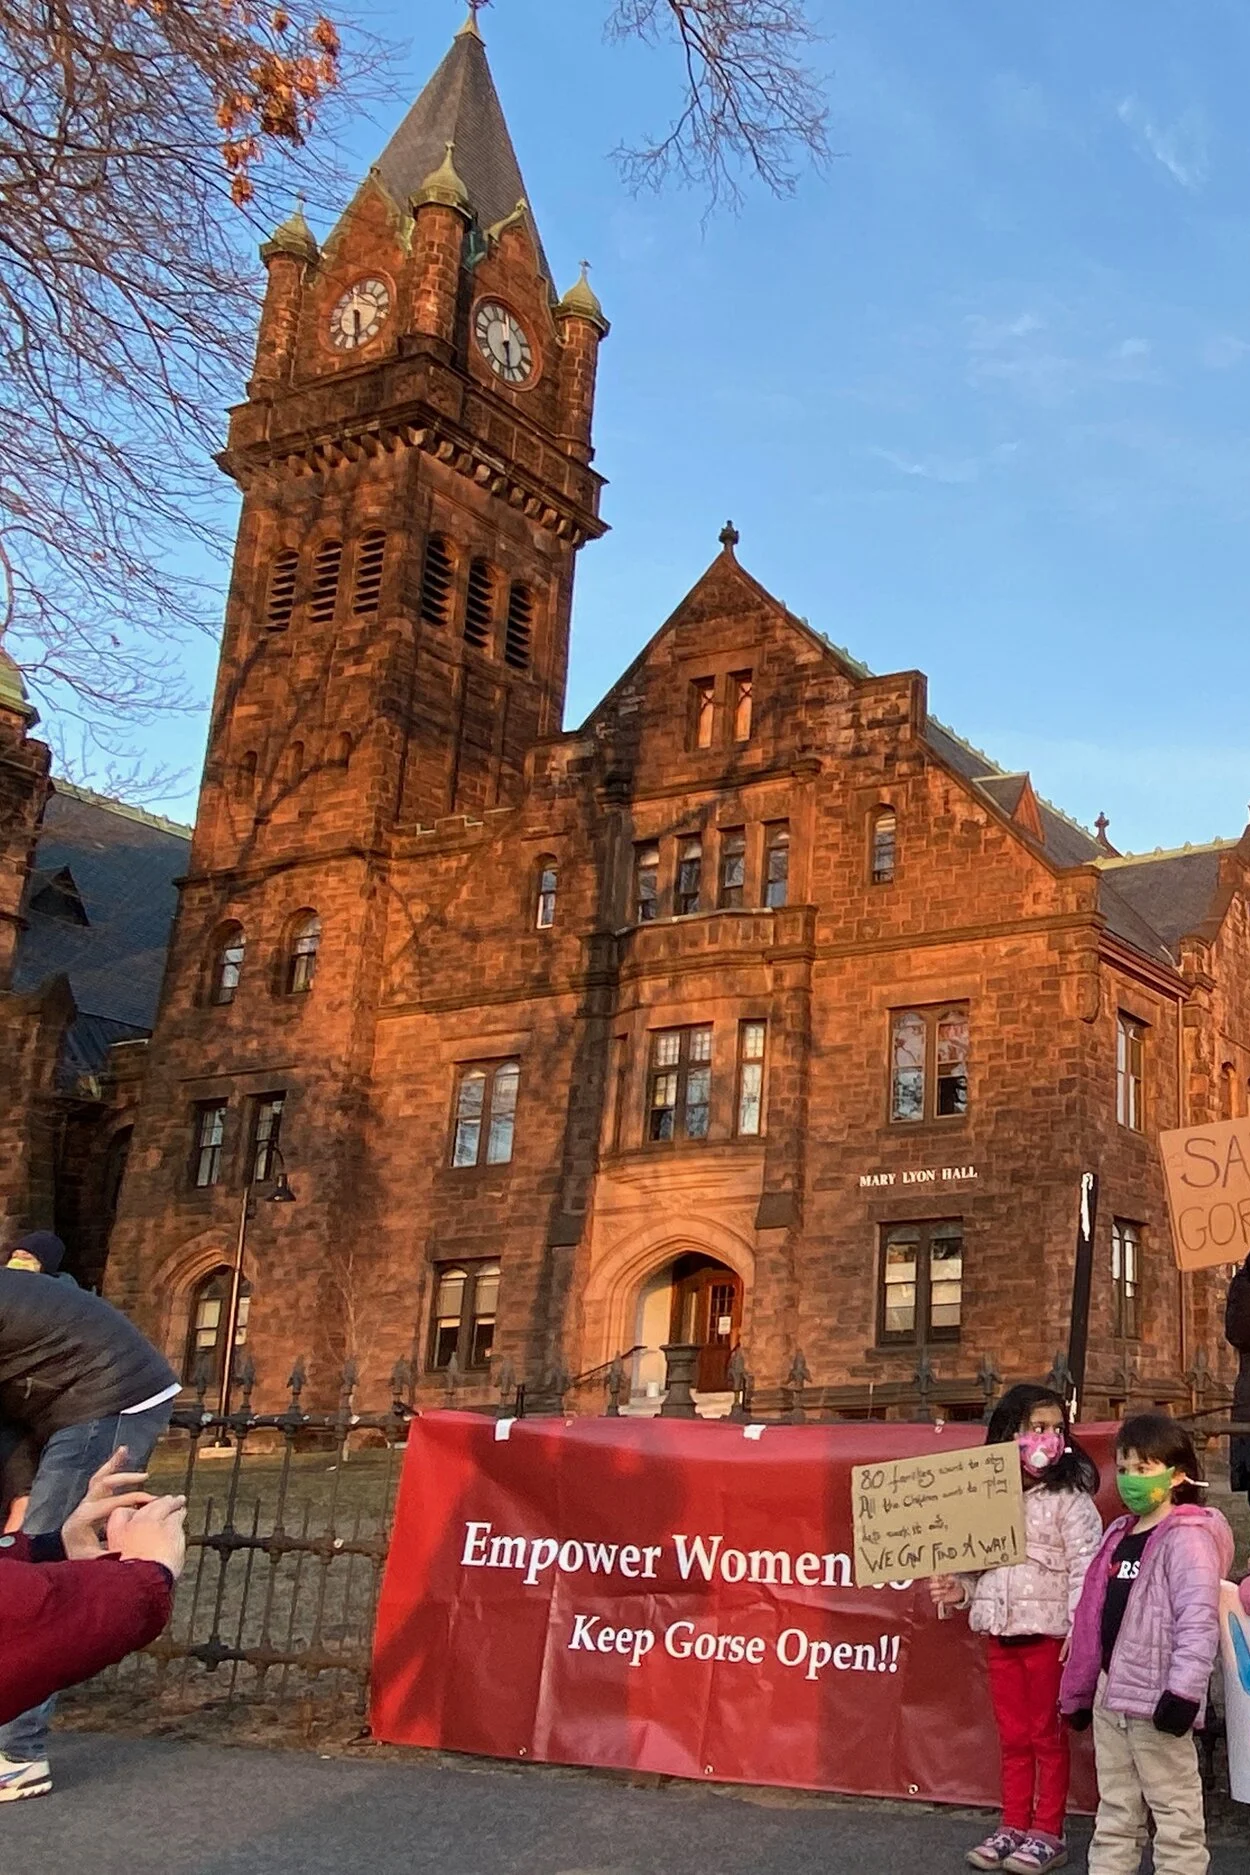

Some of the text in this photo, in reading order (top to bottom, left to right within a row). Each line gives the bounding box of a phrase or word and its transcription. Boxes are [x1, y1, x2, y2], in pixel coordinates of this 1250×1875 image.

[860, 1166, 978, 1187] MARY LYON HALL
[861, 1469, 885, 1490] 80
[461, 1521, 853, 1587] Empower Women
[859, 1546, 894, 1573] WE
[568, 1614, 900, 1681] Keep Gorse Open!!
